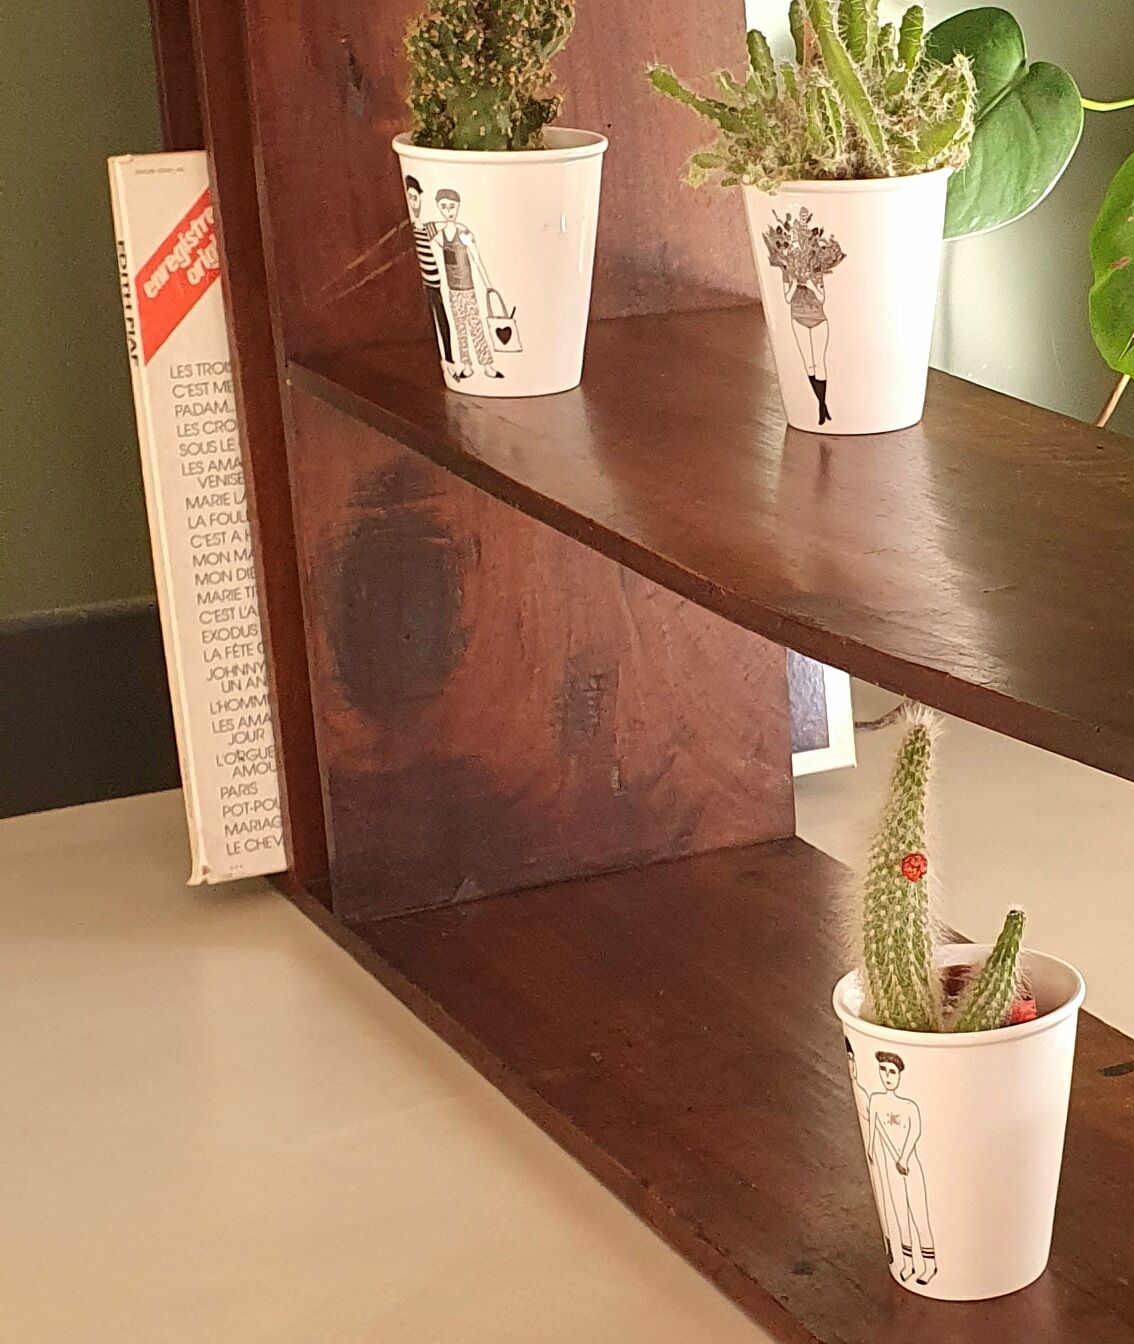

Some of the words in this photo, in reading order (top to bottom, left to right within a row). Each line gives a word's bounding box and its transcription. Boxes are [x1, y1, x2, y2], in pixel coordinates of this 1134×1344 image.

[170, 364, 193, 379] LES
[172, 382, 209, 398] C'EST
[177, 422, 200, 438] LES
[202, 419, 237, 435] CRO
[179, 440, 217, 457] SOUS
[220, 438, 235, 452] LE
[181, 460, 204, 476] LES
[197, 472, 244, 489] VENISE
[186, 492, 231, 510] MARIE
[188, 515, 207, 529] LA
[190, 531, 226, 548] C'EST
[192, 549, 231, 567] MON
[195, 569, 232, 586] MON
[197, 587, 242, 605] MARIE
[199, 608, 235, 624] C'EST
[202, 624, 258, 643] EXODUS
[203, 647, 222, 662] LA
[206, 661, 266, 681] JOHNNY
[221, 680, 241, 693] UN
[212, 719, 235, 734] LES
[228, 729, 265, 746] JOUR
[220, 782, 258, 799] PARIS
[226, 841, 241, 856] LE
